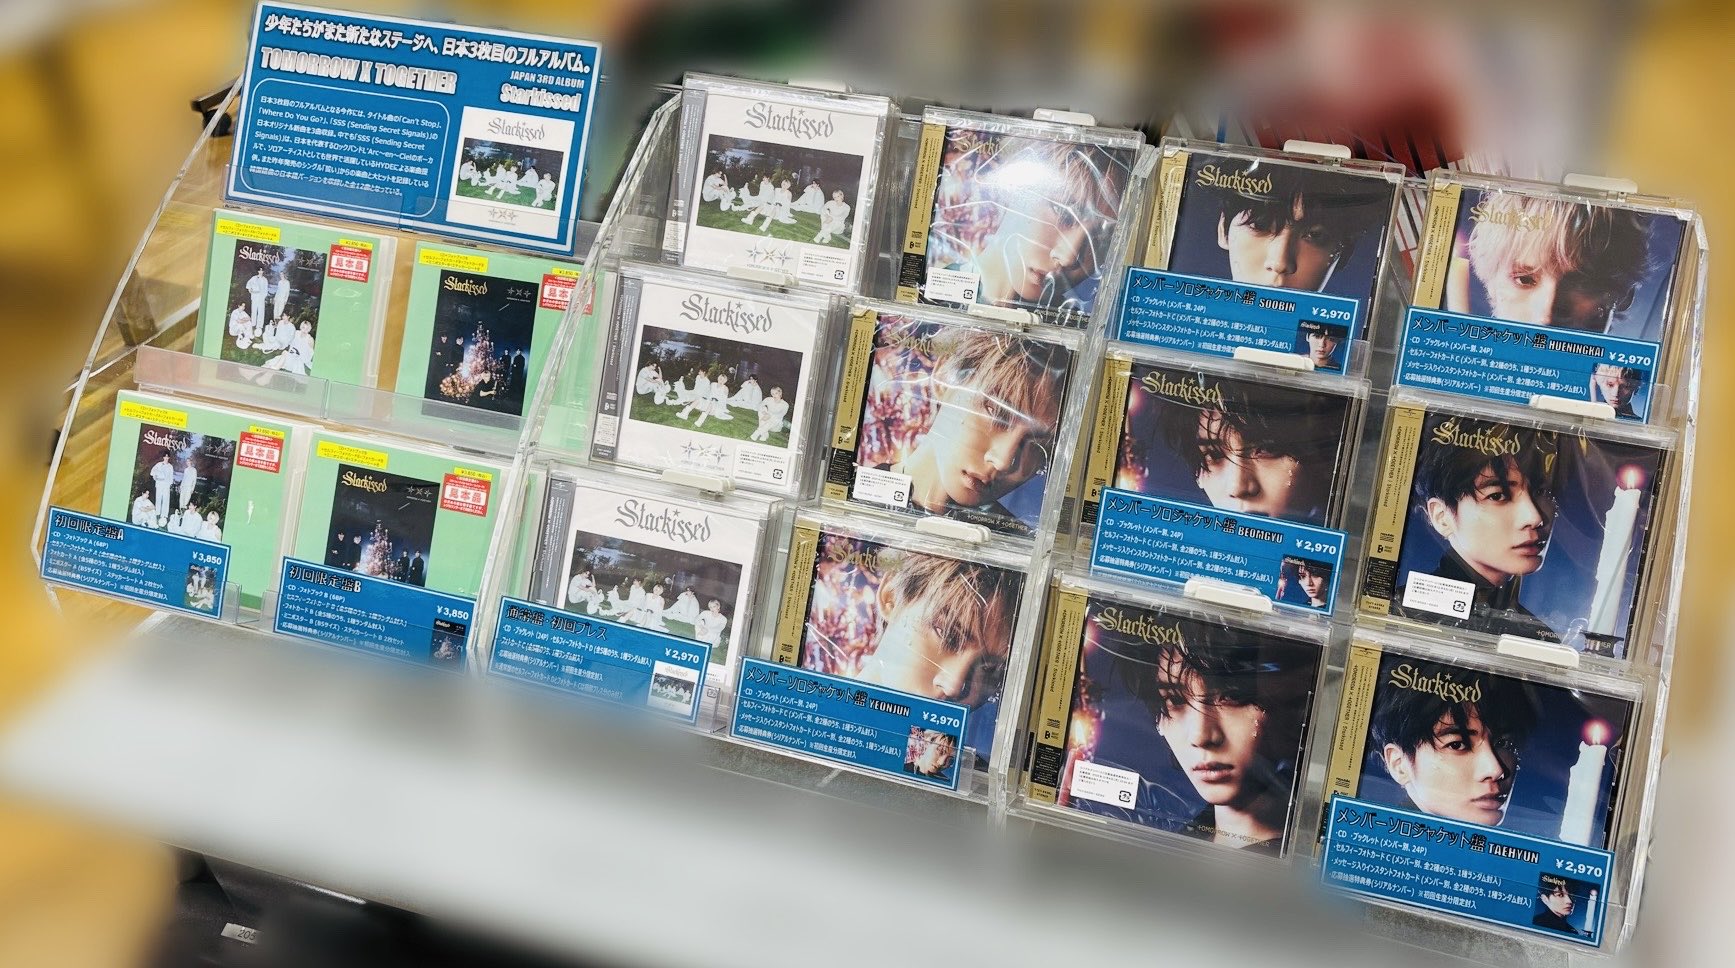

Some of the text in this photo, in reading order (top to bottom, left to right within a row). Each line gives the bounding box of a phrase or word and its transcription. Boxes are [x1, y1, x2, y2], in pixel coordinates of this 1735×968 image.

[264, 13, 592, 75] 少年たちがまた新たなステージへ、日本3枚目のフルアルバム。
[259, 46, 457, 94] TOMORROW X TOGETHER
[510, 71, 584, 88] JAPAN 3RD ALBUM
[499, 83, 581, 112] Starkissed
[258, 107, 284, 117] 「Where
[284, 111, 294, 119] Do
[295, 113, 308, 121] You
[347, 120, 377, 132] (Sending
[378, 125, 400, 135] Secret
[371, 137, 401, 148] (Sending
[402, 141, 424, 150] Secret
[1132, 274, 1296, 312] メンバーソロジャケット盤 SOOBIN
[1311, 307, 1350, 321] ¥2,970
[1412, 316, 1605, 357] メンバーソロジャケット盤 HUENINGKAI
[1608, 351, 1651, 366] ¥2,970
[54, 513, 124, 541] 初回限定盤A
[1106, 495, 1283, 544] メンバーソロジャケット盤 BEOMGYU
[192, 551, 222, 565] ¥3,850
[1295, 538, 1336, 555] ¥2,970
[288, 565, 361, 593] 初回限定盤B
[436, 605, 469, 620] ¥3,850
[664, 647, 699, 663] ¥2,970
[745, 665, 910, 717] メンバーソロジャケット盤 YEONJUN
[921, 711, 960, 728] ¥2,970
[1335, 806, 1539, 864] メンバーソロジャケット盤 TAEHYUN
[1554, 858, 1603, 878] ¥2,970
[238, 929, 257, 941] 205
